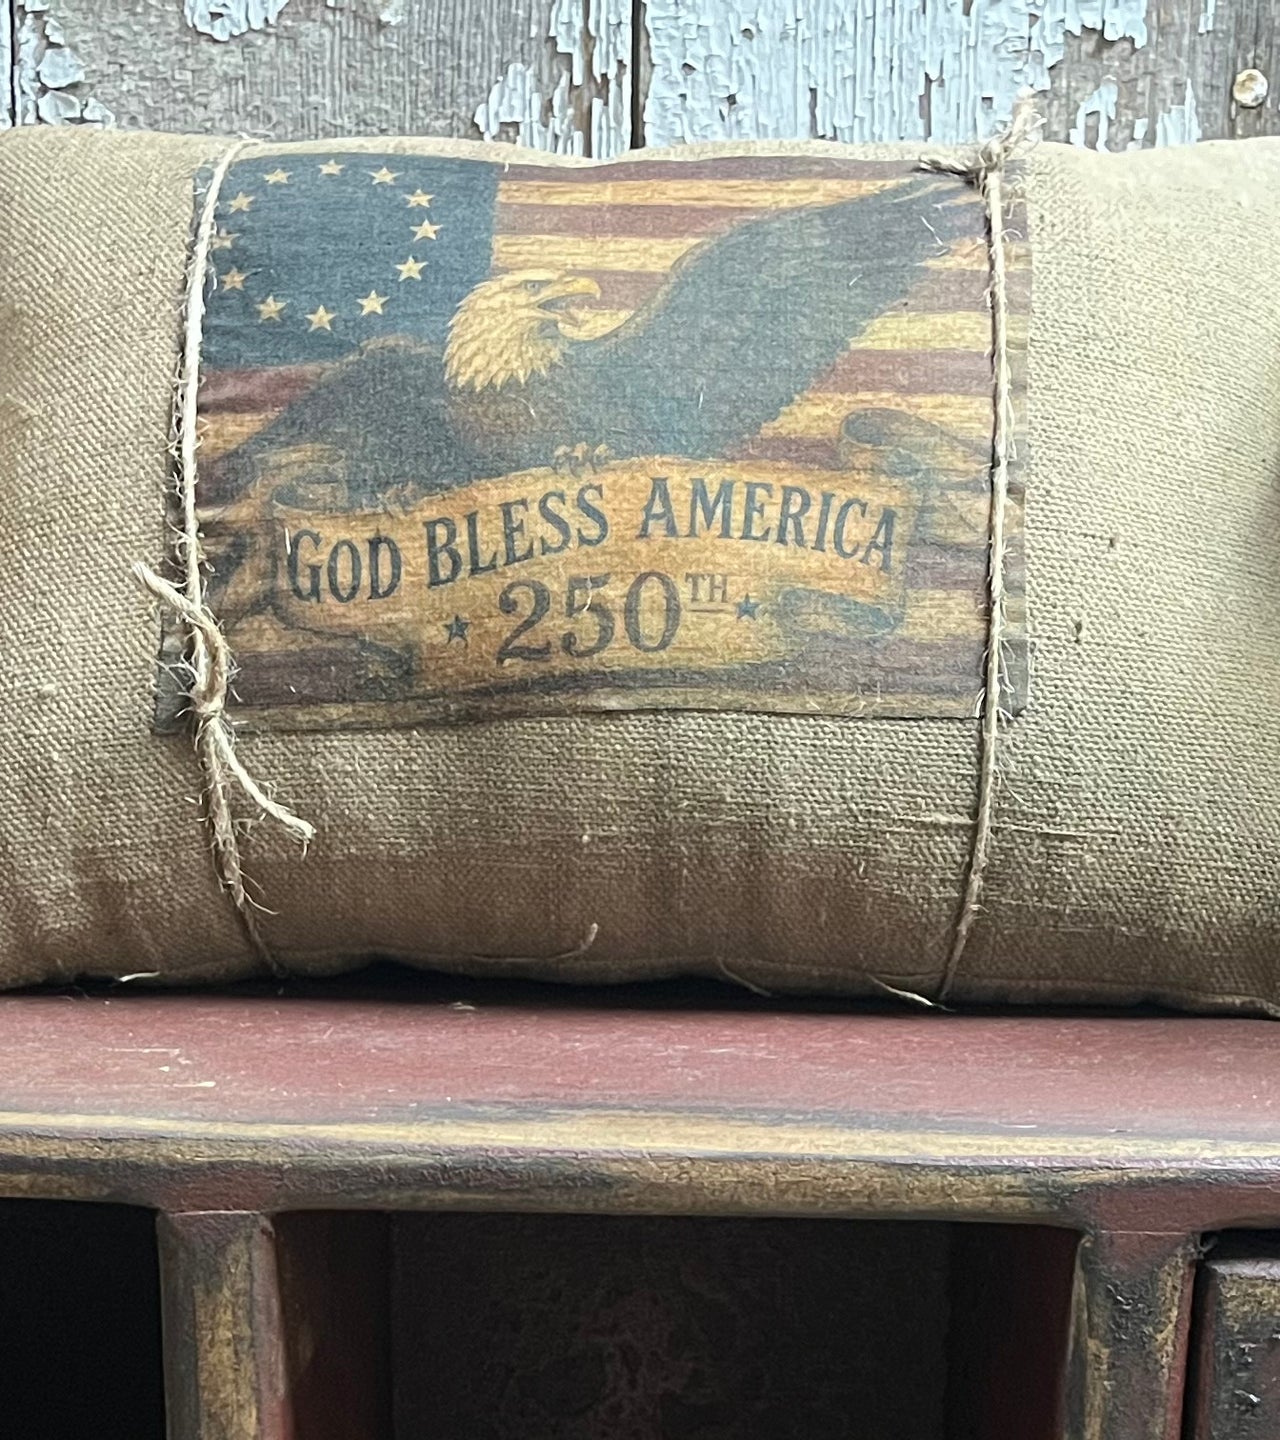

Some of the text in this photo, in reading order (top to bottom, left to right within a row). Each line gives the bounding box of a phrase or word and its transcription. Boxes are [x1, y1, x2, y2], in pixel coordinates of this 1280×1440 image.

[287, 476, 897, 603] GOD BLESS AMERICA
